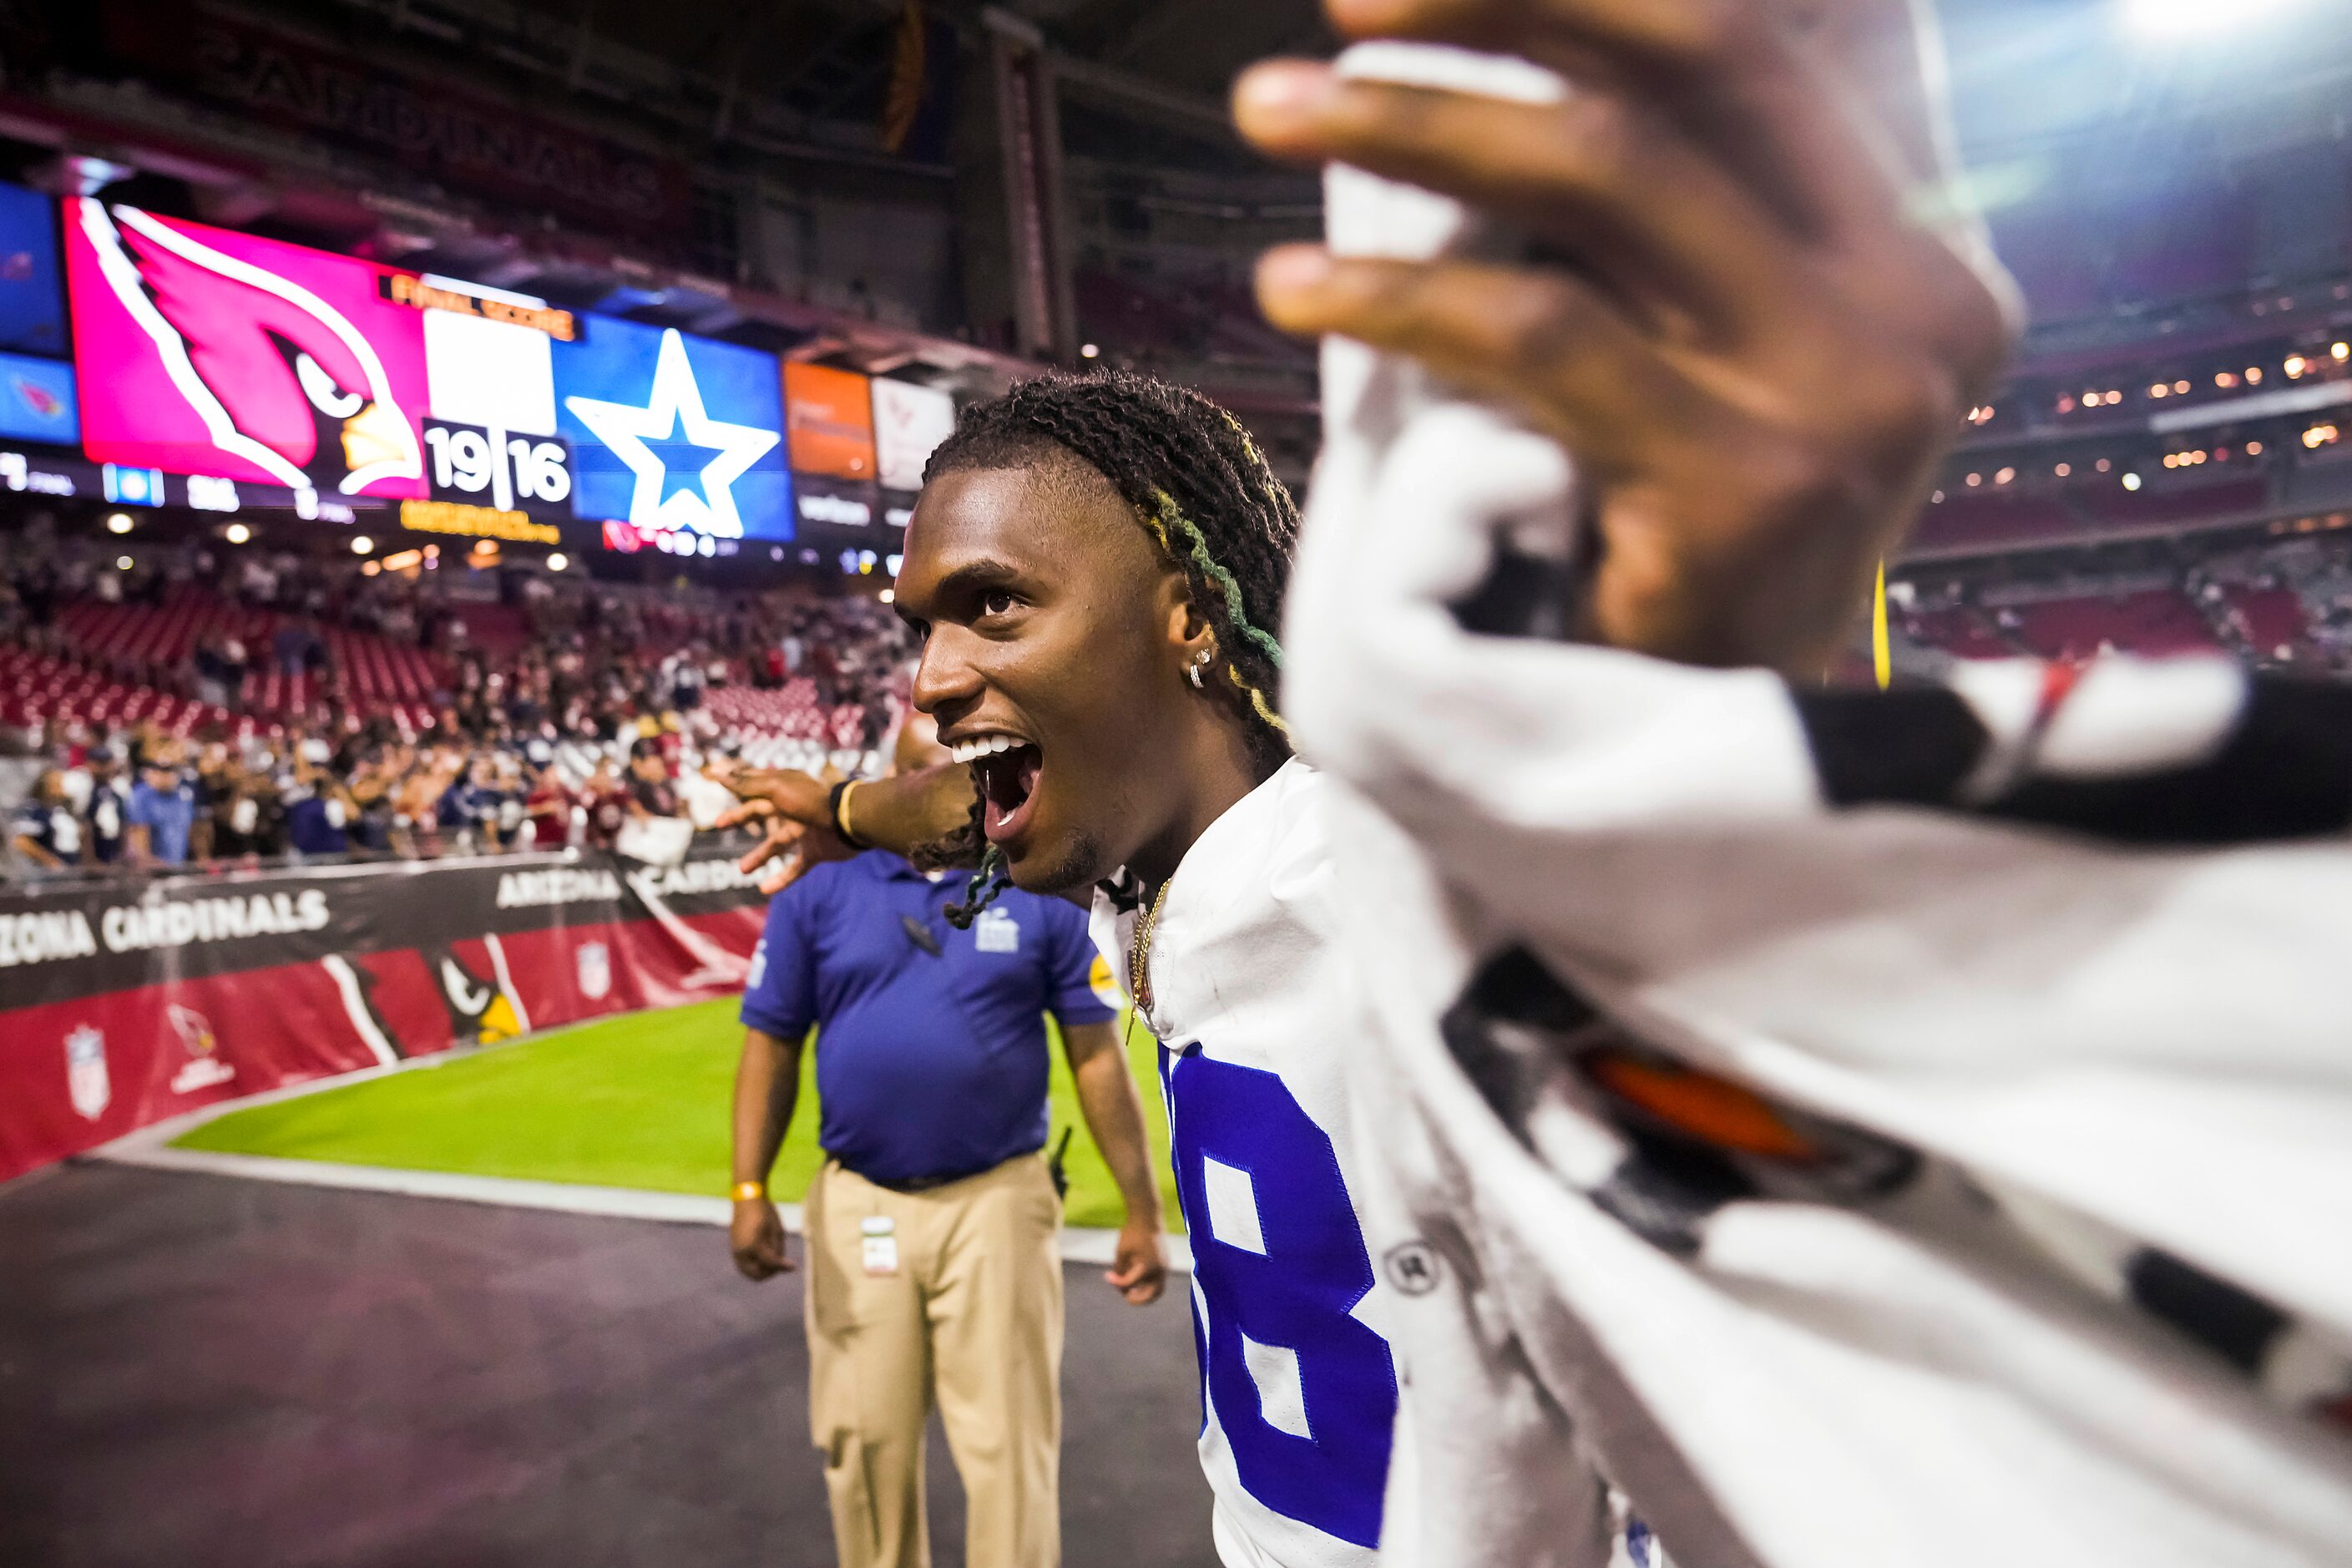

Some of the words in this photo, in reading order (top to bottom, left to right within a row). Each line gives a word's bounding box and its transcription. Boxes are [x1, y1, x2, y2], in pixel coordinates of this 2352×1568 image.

[424, 427, 493, 493] 19
[507, 439, 571, 502] 16
[496, 869, 623, 908] ARIZONA
[101, 889, 330, 953] CARDINALS
[1157, 1040, 1401, 1550] 8
